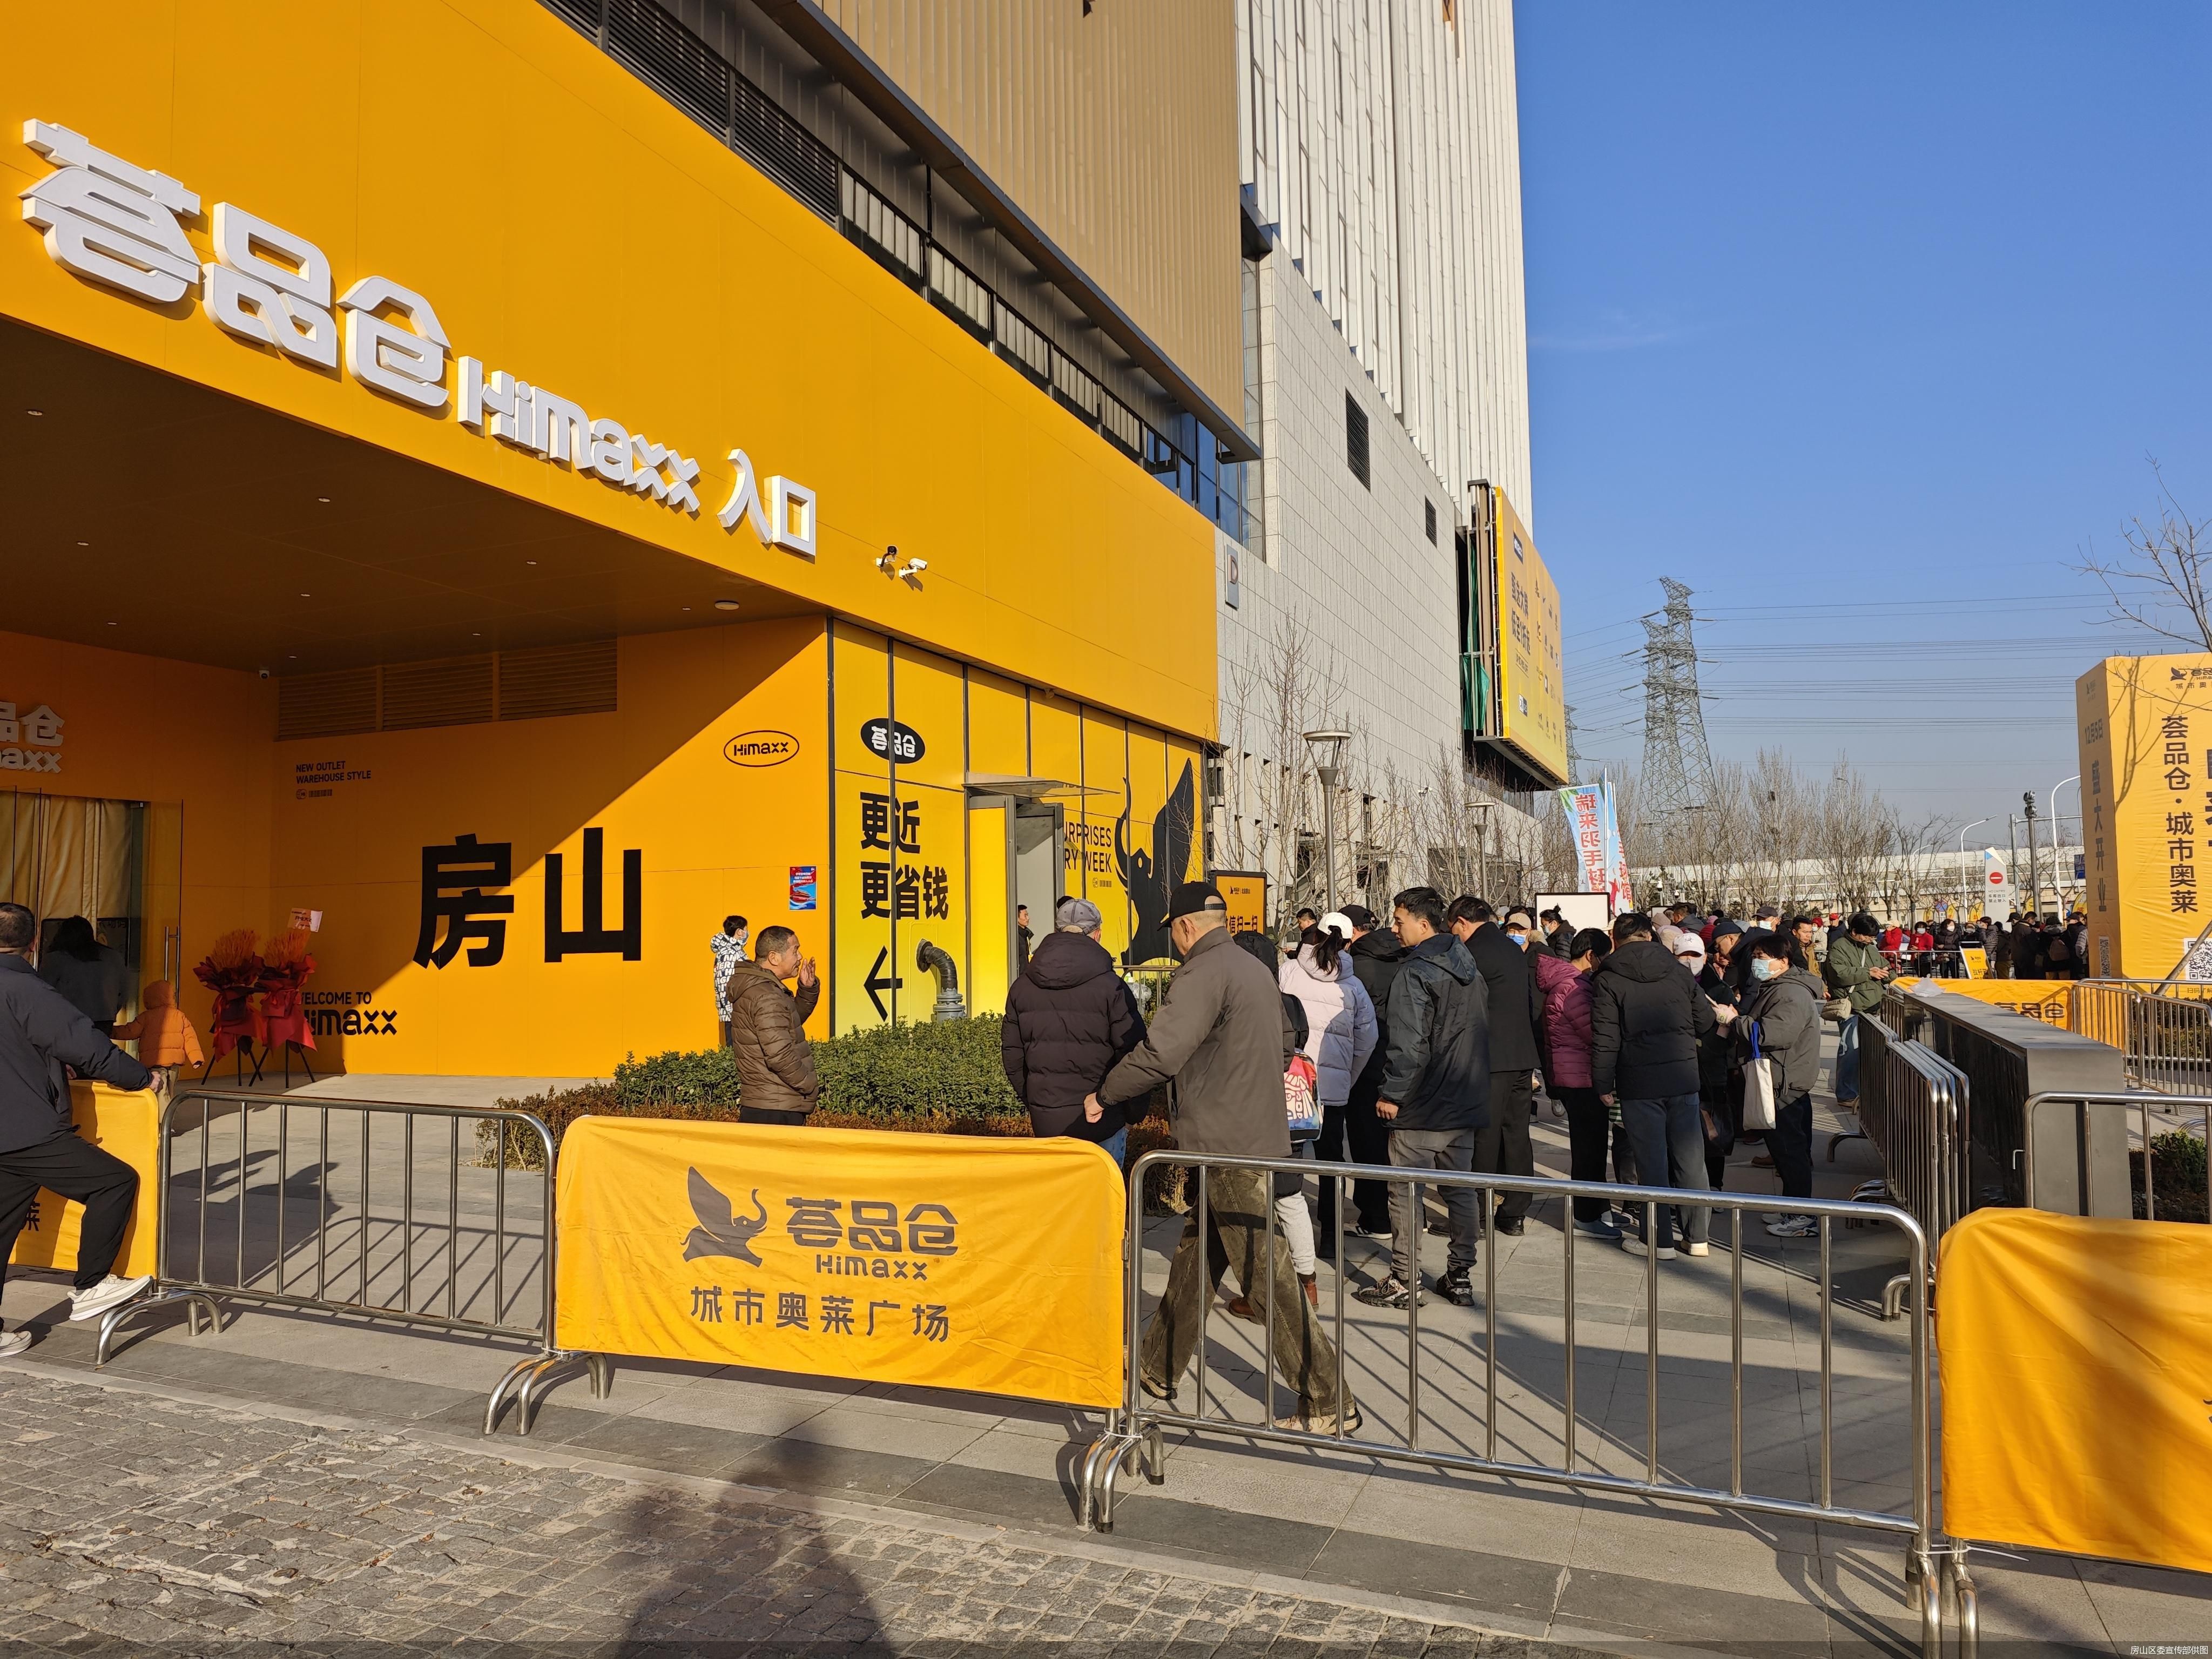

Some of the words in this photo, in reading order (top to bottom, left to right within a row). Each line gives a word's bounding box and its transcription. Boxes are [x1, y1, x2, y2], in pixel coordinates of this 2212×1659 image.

[18, 118, 451, 408] 荟品仓
[457, 355, 700, 512] Himaxx
[717, 448, 816, 557] 入口
[871, 726, 916, 758] 荟品仓
[2085, 718, 2103, 745] 12月5日
[0, 747, 62, 773] axx
[733, 741, 790, 757] Himaxx
[296, 764, 314, 772] NEW
[316, 761, 346, 771] OUTLET
[296, 773, 345, 784] WAREHOUSE
[347, 770, 372, 781] STYLE
[860, 791, 920, 854] 更近
[2092, 759, 2107, 912] 盛大开业
[1083, 851, 1112, 873] WEEK
[413, 827, 642, 970] 房山
[860, 861, 949, 920] 更省钱
[302, 992, 352, 1005] ELCOME
[356, 992, 372, 1004] TO
[786, 1197, 959, 1256] 荟品仓
[816, 1254, 928, 1281] Himaxx
[690, 1285, 949, 1343] 城市奥莱广场
